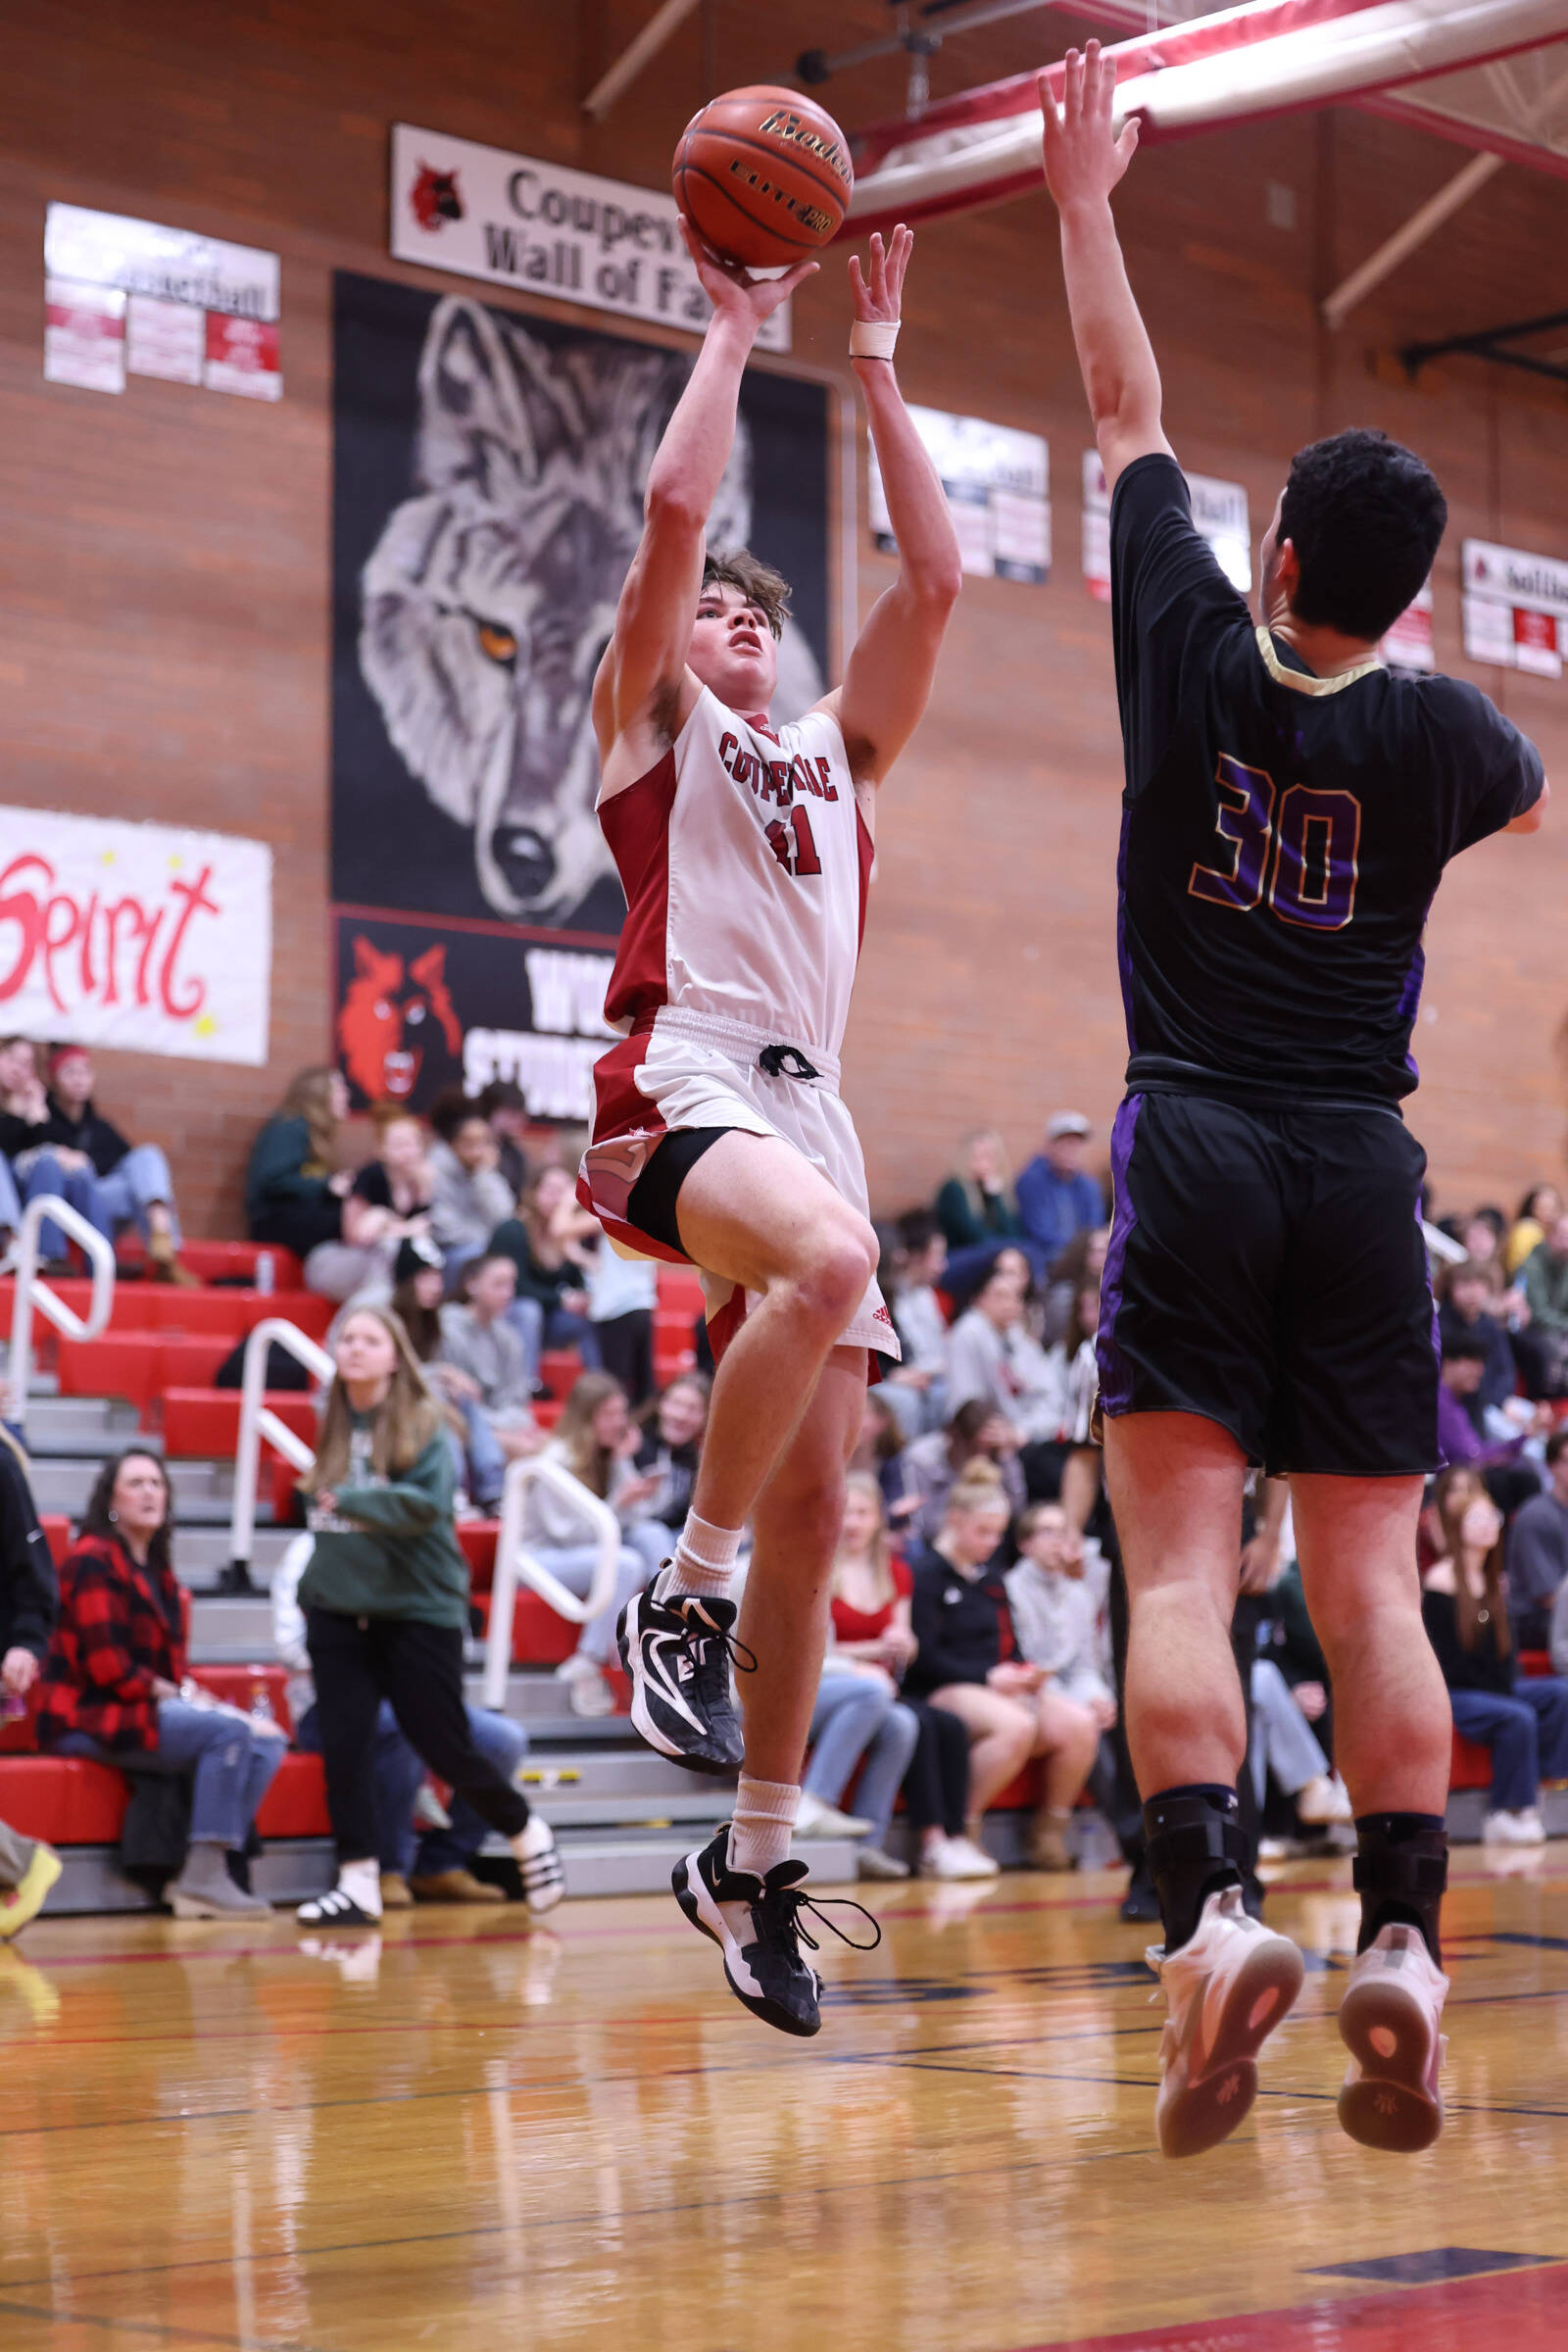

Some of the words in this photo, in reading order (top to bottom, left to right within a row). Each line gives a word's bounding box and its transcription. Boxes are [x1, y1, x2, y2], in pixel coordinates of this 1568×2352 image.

[508, 169, 691, 257] Coupev
[802, 204, 834, 236] PRO
[483, 223, 585, 291] Wall
[596, 256, 643, 304] of
[1188, 751, 1361, 931] 30
